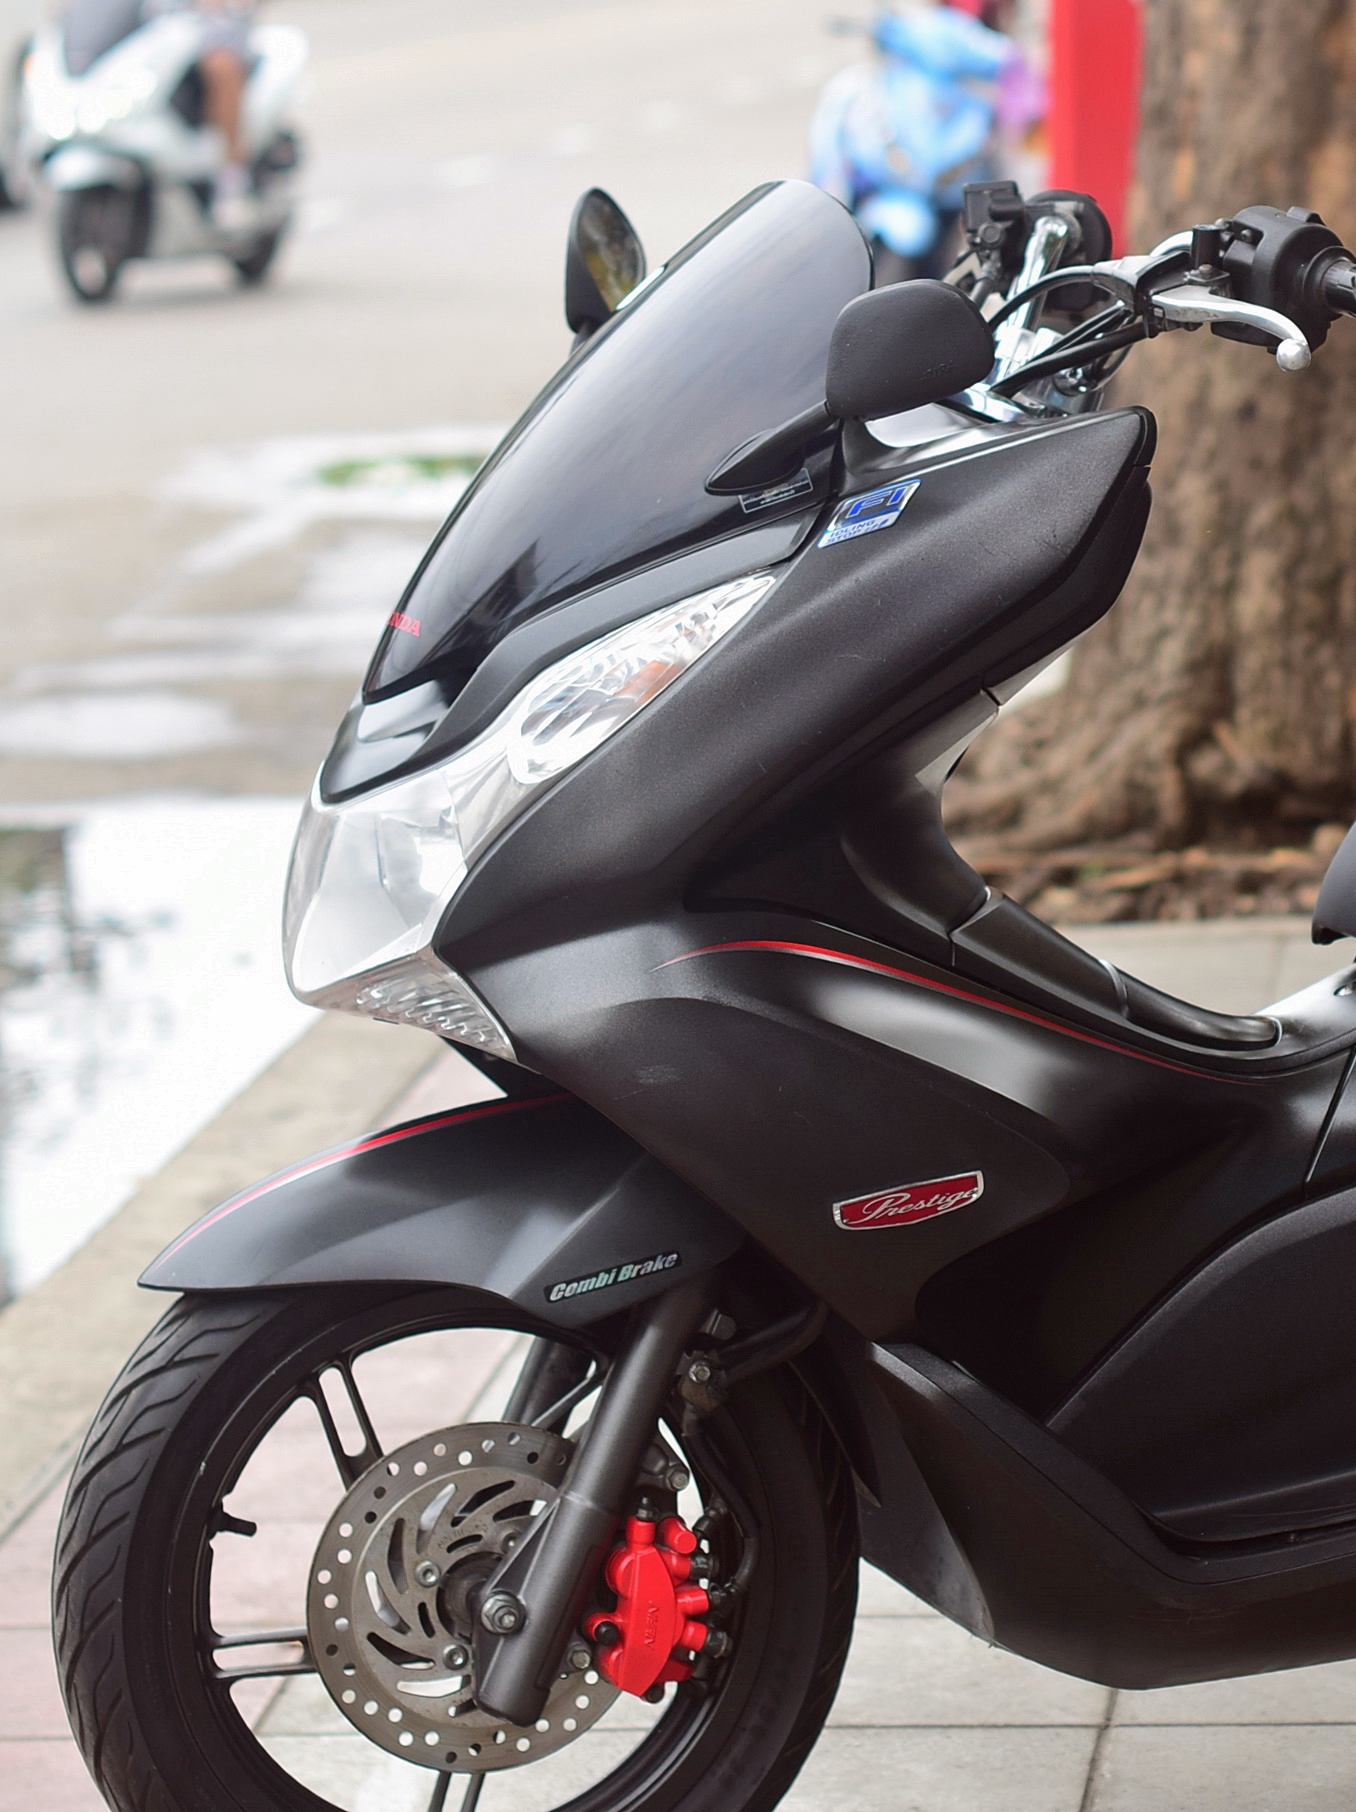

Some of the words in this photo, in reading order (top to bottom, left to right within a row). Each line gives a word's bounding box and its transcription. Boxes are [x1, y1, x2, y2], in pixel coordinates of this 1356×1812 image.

[827, 529, 862, 545] STOP
[830, 519, 876, 538] IDLING
[846, 1187, 979, 1225] Prestige
[550, 1269, 618, 1301] Combi
[617, 1252, 679, 1282] Brake
